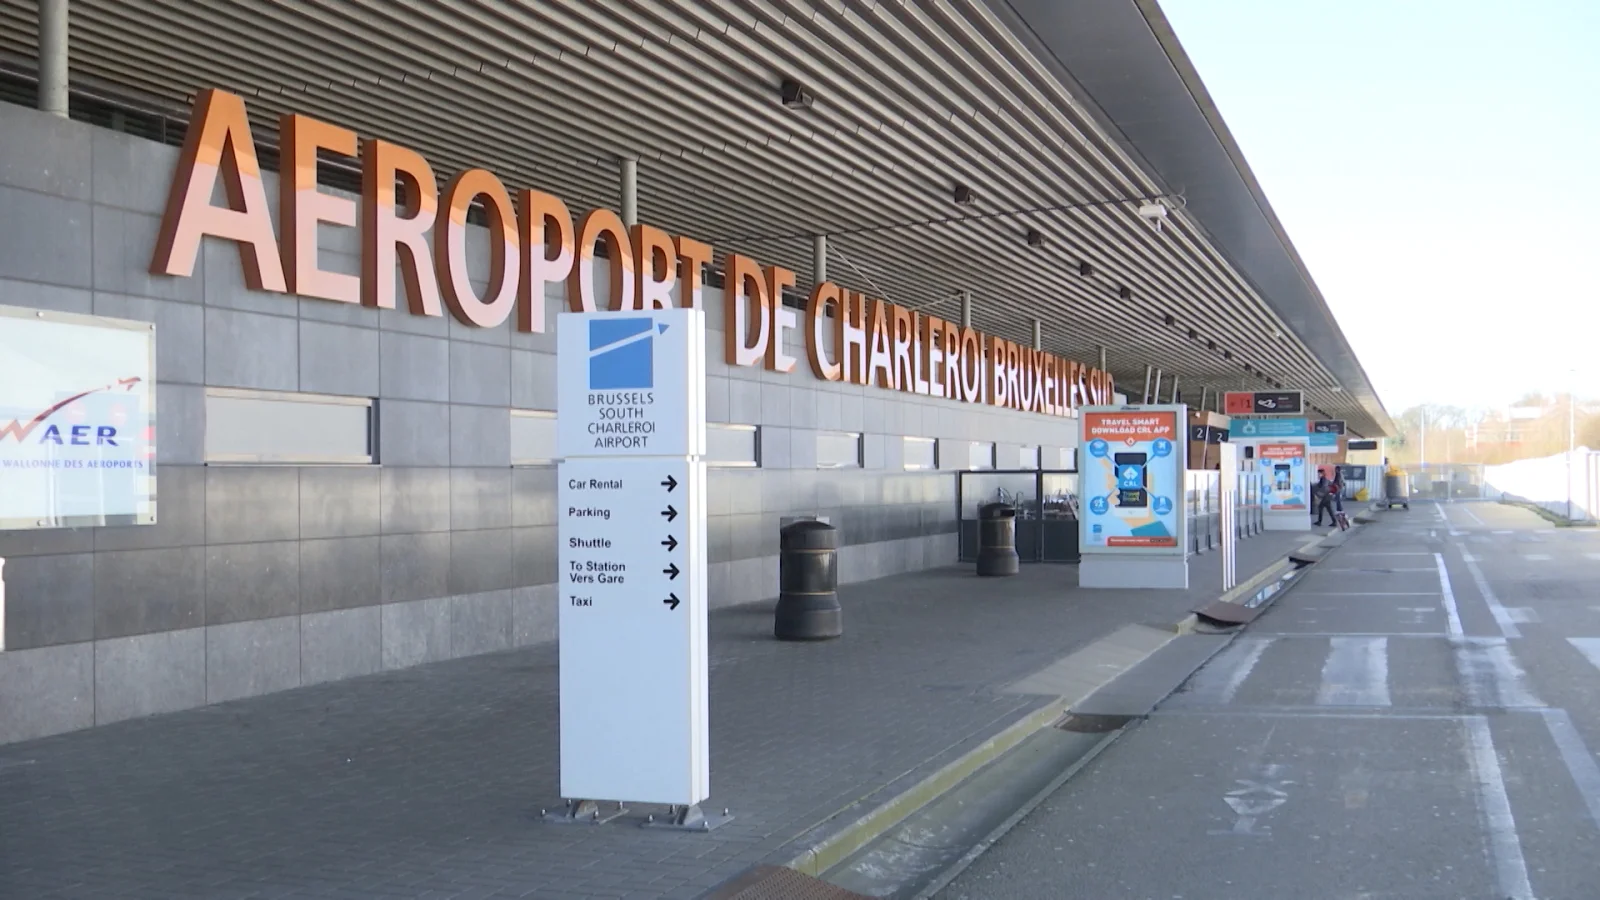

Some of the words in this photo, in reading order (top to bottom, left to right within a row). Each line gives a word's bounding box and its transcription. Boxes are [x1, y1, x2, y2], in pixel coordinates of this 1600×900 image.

[150, 88, 714, 333] AEROPORT
[726, 254, 796, 373] DE
[806, 280, 988, 405] CHARLEROI
[990, 335, 1089, 418] BRUXELLES
[588, 392, 654, 405] BRUSSELS
[599, 407, 643, 420] SOUTH
[587, 421, 656, 434] CHARLEROI
[1196, 427, 1204, 439] 2
[38, 424, 119, 446] AER
[1216, 432, 1223, 442] 2
[594, 436, 649, 448] AIRPORT
[2, 459, 61, 469] WALLONNE
[64, 459, 84, 469] DES
[568, 479, 587, 490] Car
[589, 479, 623, 490] Rental
[568, 507, 611, 520] Parking
[569, 537, 612, 548] Shuttle
[569, 560, 583, 572] To
[586, 560, 626, 572] Station
[569, 573, 594, 584] Vers
[597, 573, 625, 584] Gare
[570, 596, 593, 607] Taxi
